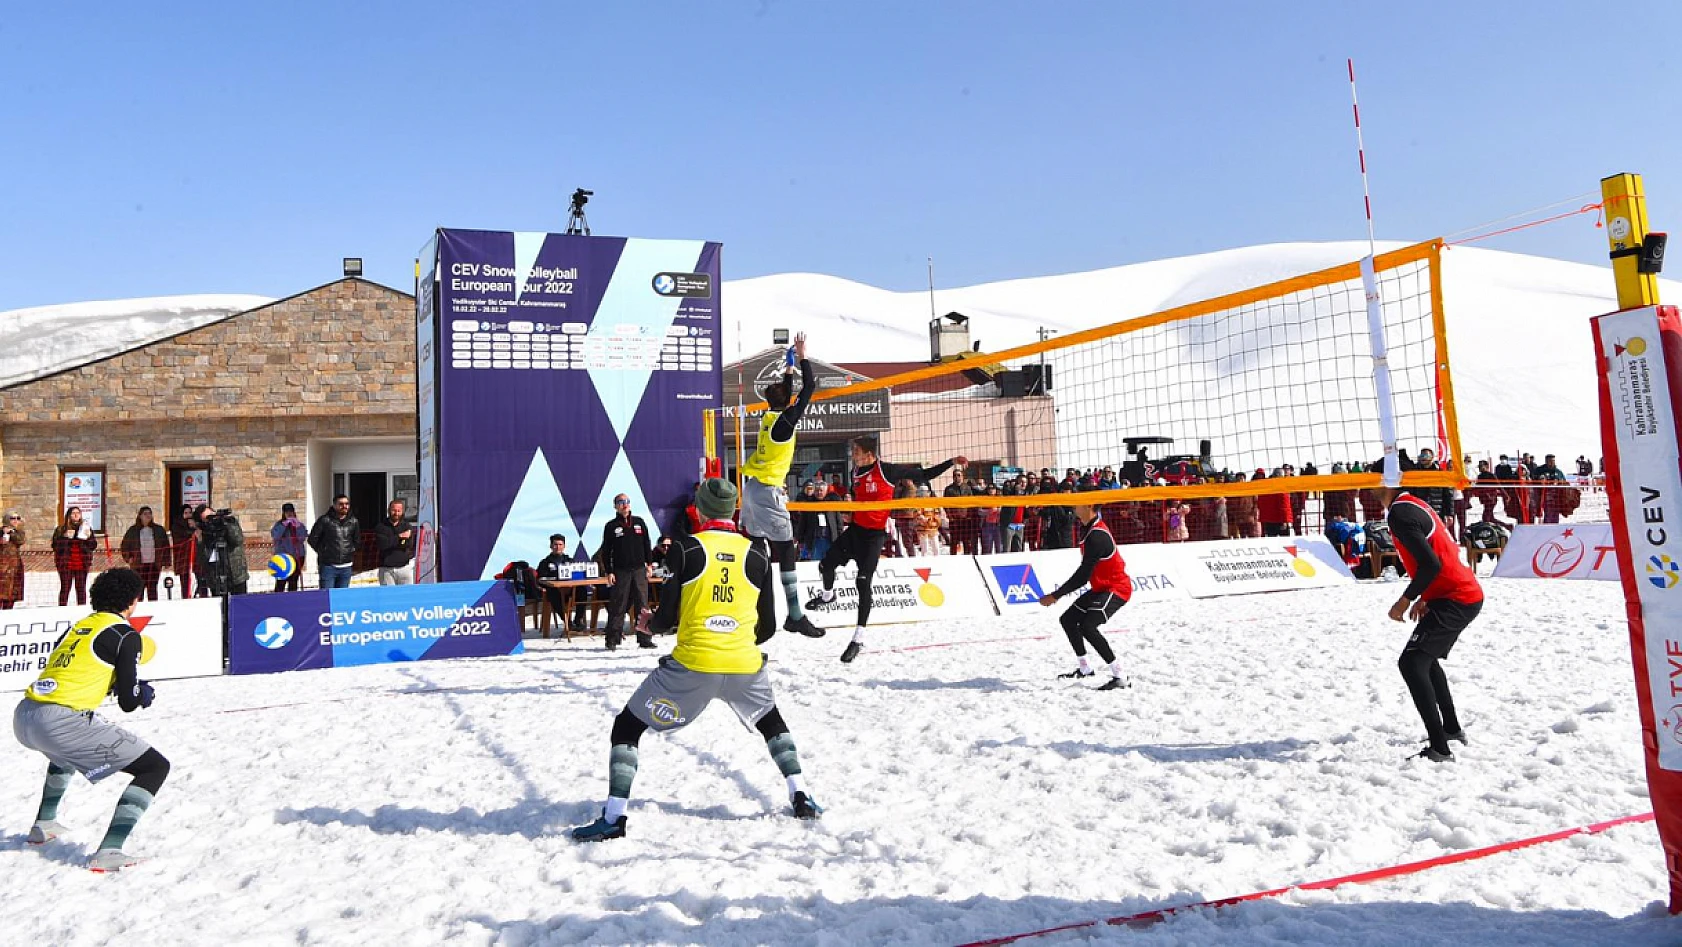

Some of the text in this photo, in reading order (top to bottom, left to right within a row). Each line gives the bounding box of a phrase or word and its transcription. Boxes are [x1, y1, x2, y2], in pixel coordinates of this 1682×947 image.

[452, 263, 578, 281] CEV Snow olleyball
[452, 278, 573, 295] European our 2022
[1628, 359, 1646, 436] Kahramanmaraş
[829, 399, 882, 415] MERKEZİ
[796, 417, 824, 430] BİNA
[1640, 485, 1667, 546] CEV
[560, 568, 570, 578] 12
[720, 567, 729, 584] 3
[712, 585, 735, 602] RUS
[1005, 584, 1040, 601] AXA
[318, 602, 495, 627] CEV Snow Volleyball
[319, 621, 491, 646] European Tour 2022
